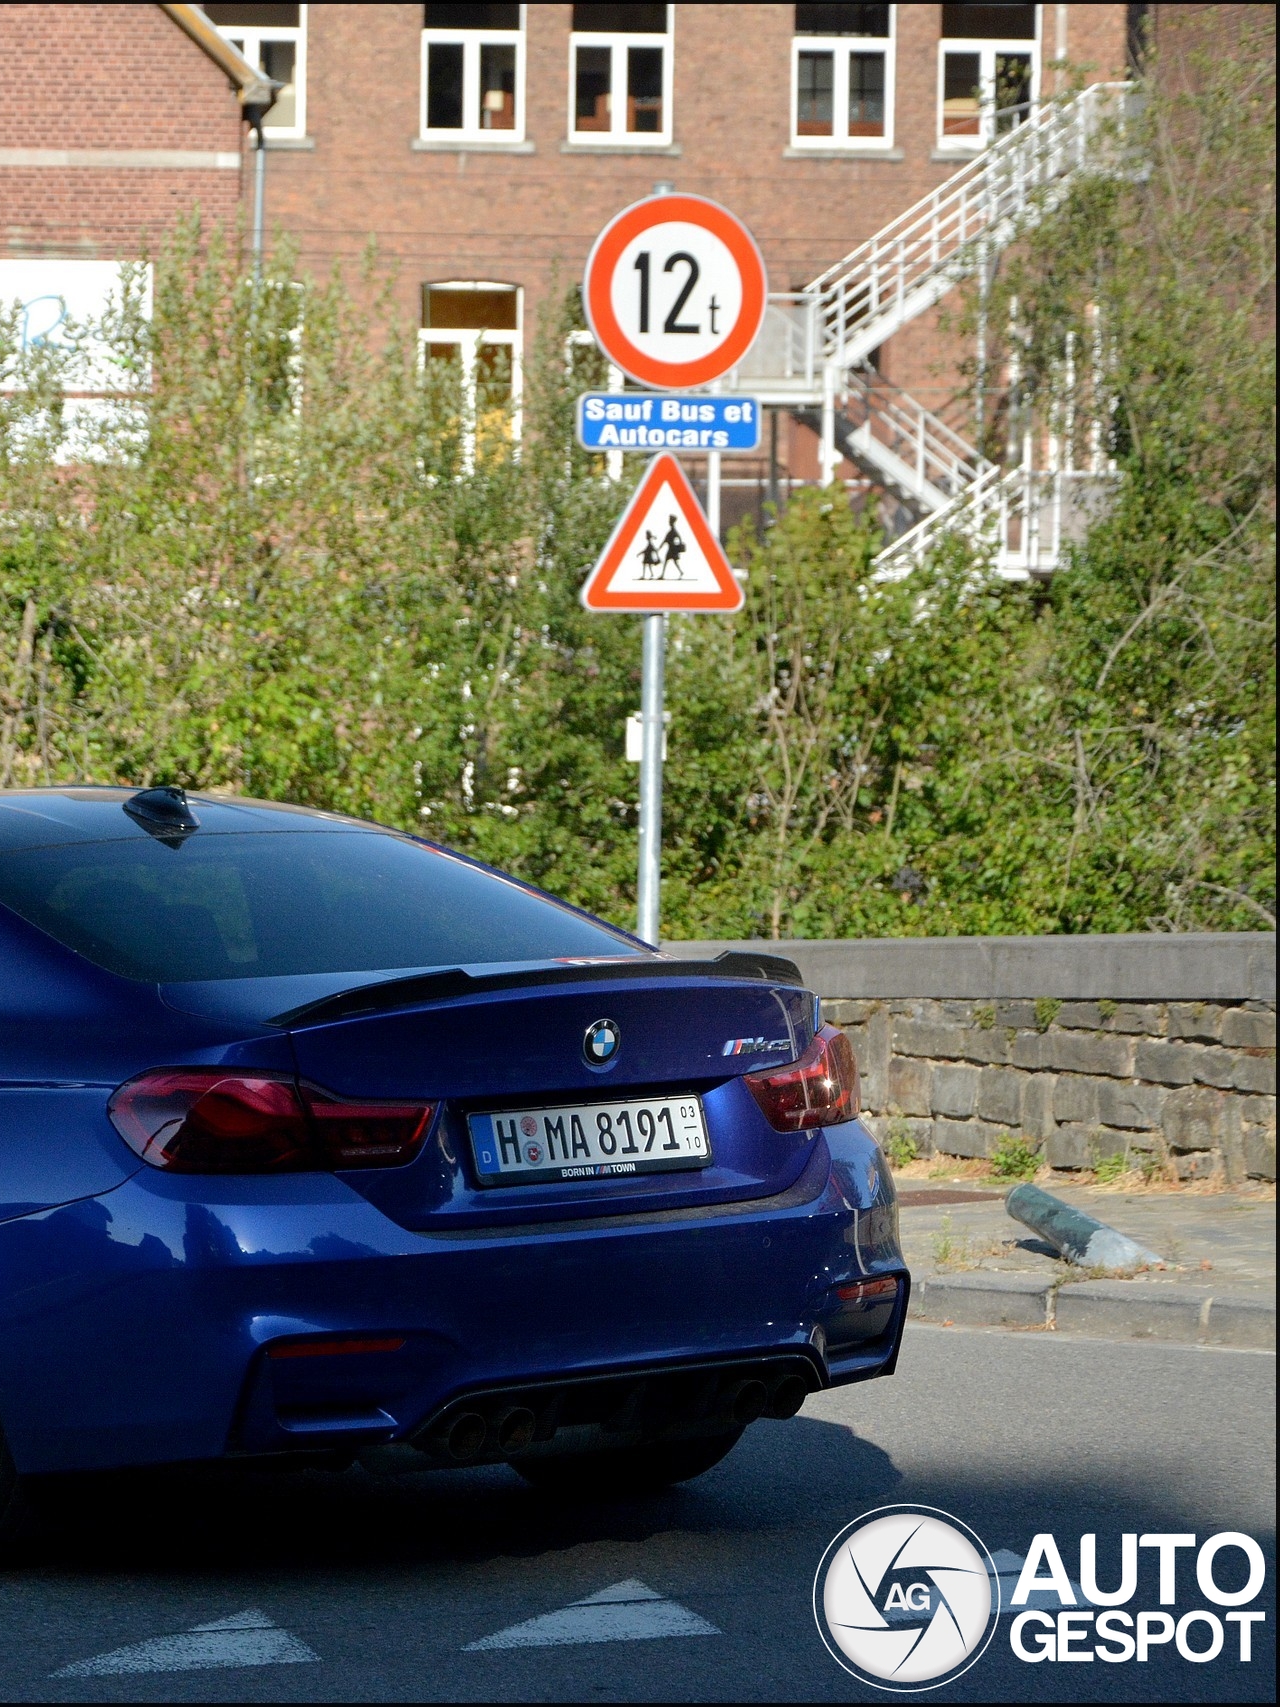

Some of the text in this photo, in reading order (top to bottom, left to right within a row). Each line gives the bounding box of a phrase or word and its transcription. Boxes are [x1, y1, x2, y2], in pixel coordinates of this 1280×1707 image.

[585, 398, 753, 424] Sauf Bus et
[598, 423, 730, 447] Autocars
[680, 1105, 696, 1119] 03
[495, 1106, 681, 1165] H MA 8191
[685, 1136, 701, 1150] 10
[482, 1151, 492, 1164] D
[561, 1167, 585, 1178] BORN
[586, 1166, 595, 1175] IN
[611, 1163, 636, 1173] TOWN
